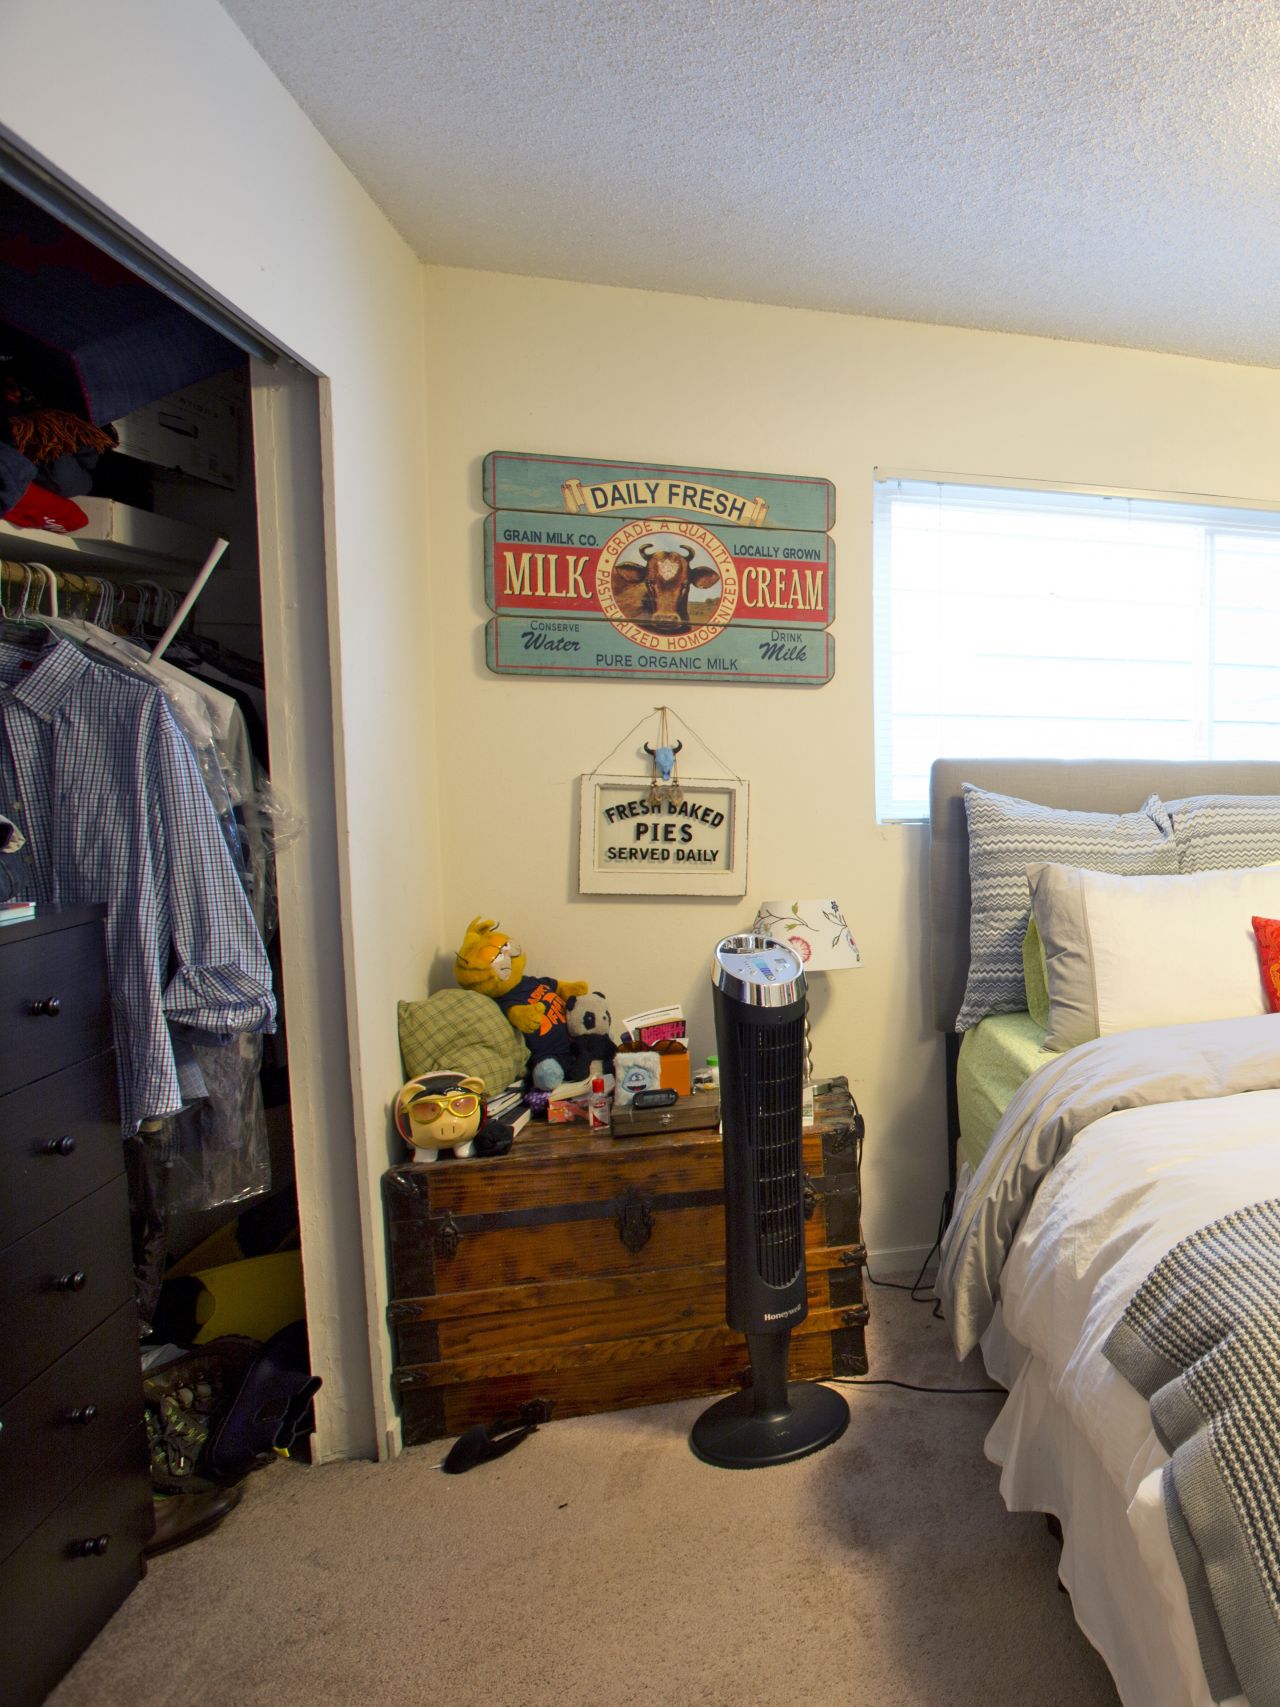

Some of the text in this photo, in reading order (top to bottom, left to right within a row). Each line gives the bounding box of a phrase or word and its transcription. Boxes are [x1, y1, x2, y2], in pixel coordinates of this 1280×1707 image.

[590, 482, 747, 521] DAILY FRESH
[503, 529, 600, 547] GRAIN MILK CO.
[606, 518, 732, 566] GRADE A QUALITY
[733, 544, 821, 560] LOCALLY GROWN
[503, 551, 594, 600] MILK
[742, 566, 825, 611] CREAM
[598, 569, 737, 650] PASTEURIZED HOMOGENIZED
[521, 631, 582, 651] Water
[759, 642, 808, 662] Milk
[595, 654, 739, 671] PURE ORGANIC MILK
[635, 822, 693, 843] PIES
[607, 846, 719, 862] SERVED DAILY
